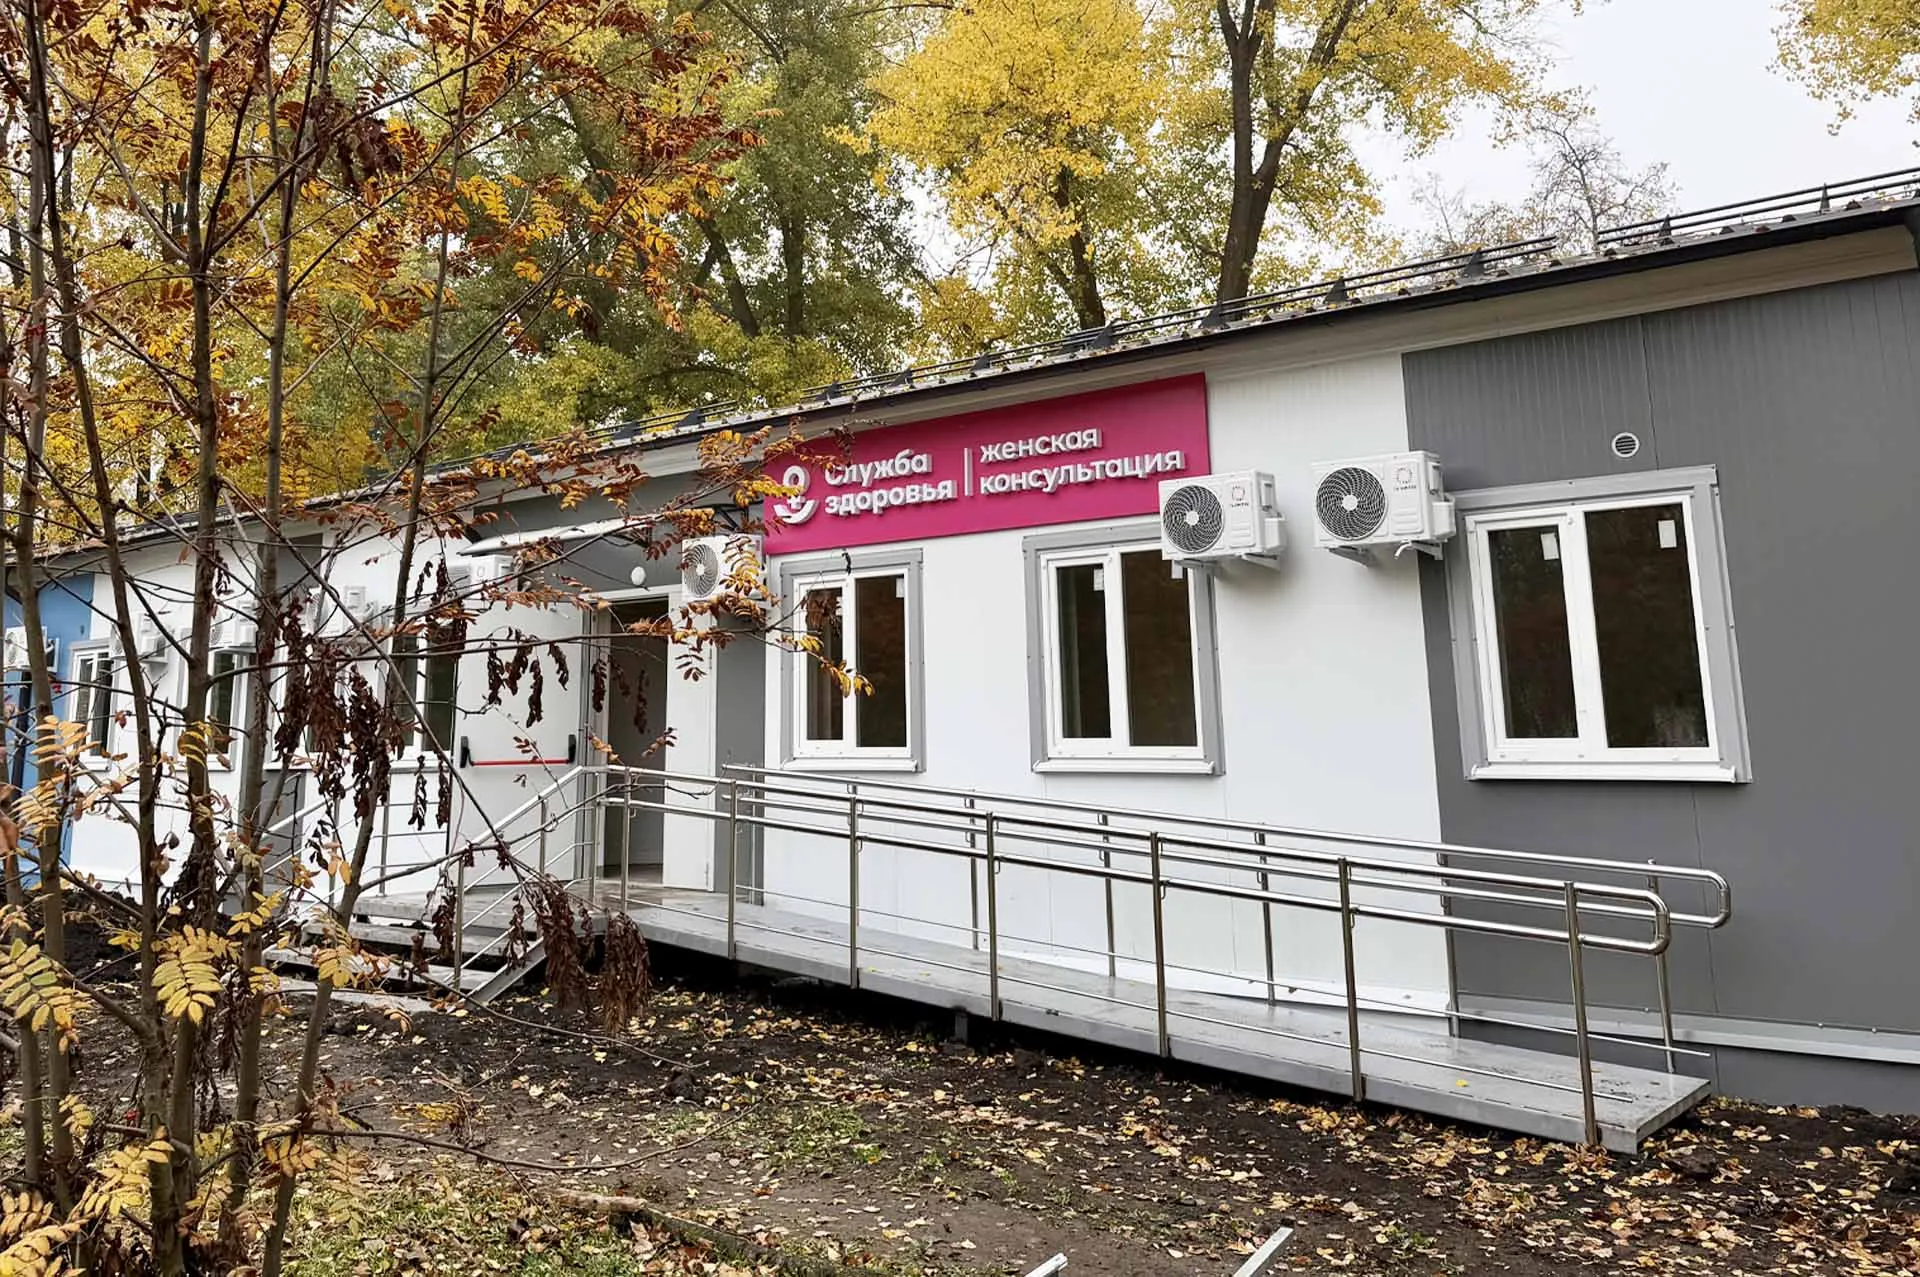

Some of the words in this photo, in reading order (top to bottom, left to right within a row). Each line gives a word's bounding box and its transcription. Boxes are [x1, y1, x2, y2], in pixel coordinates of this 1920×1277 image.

[979, 428, 1101, 462] женская
[979, 450, 1184, 493] консультация
[825, 479, 957, 515] здоровья
